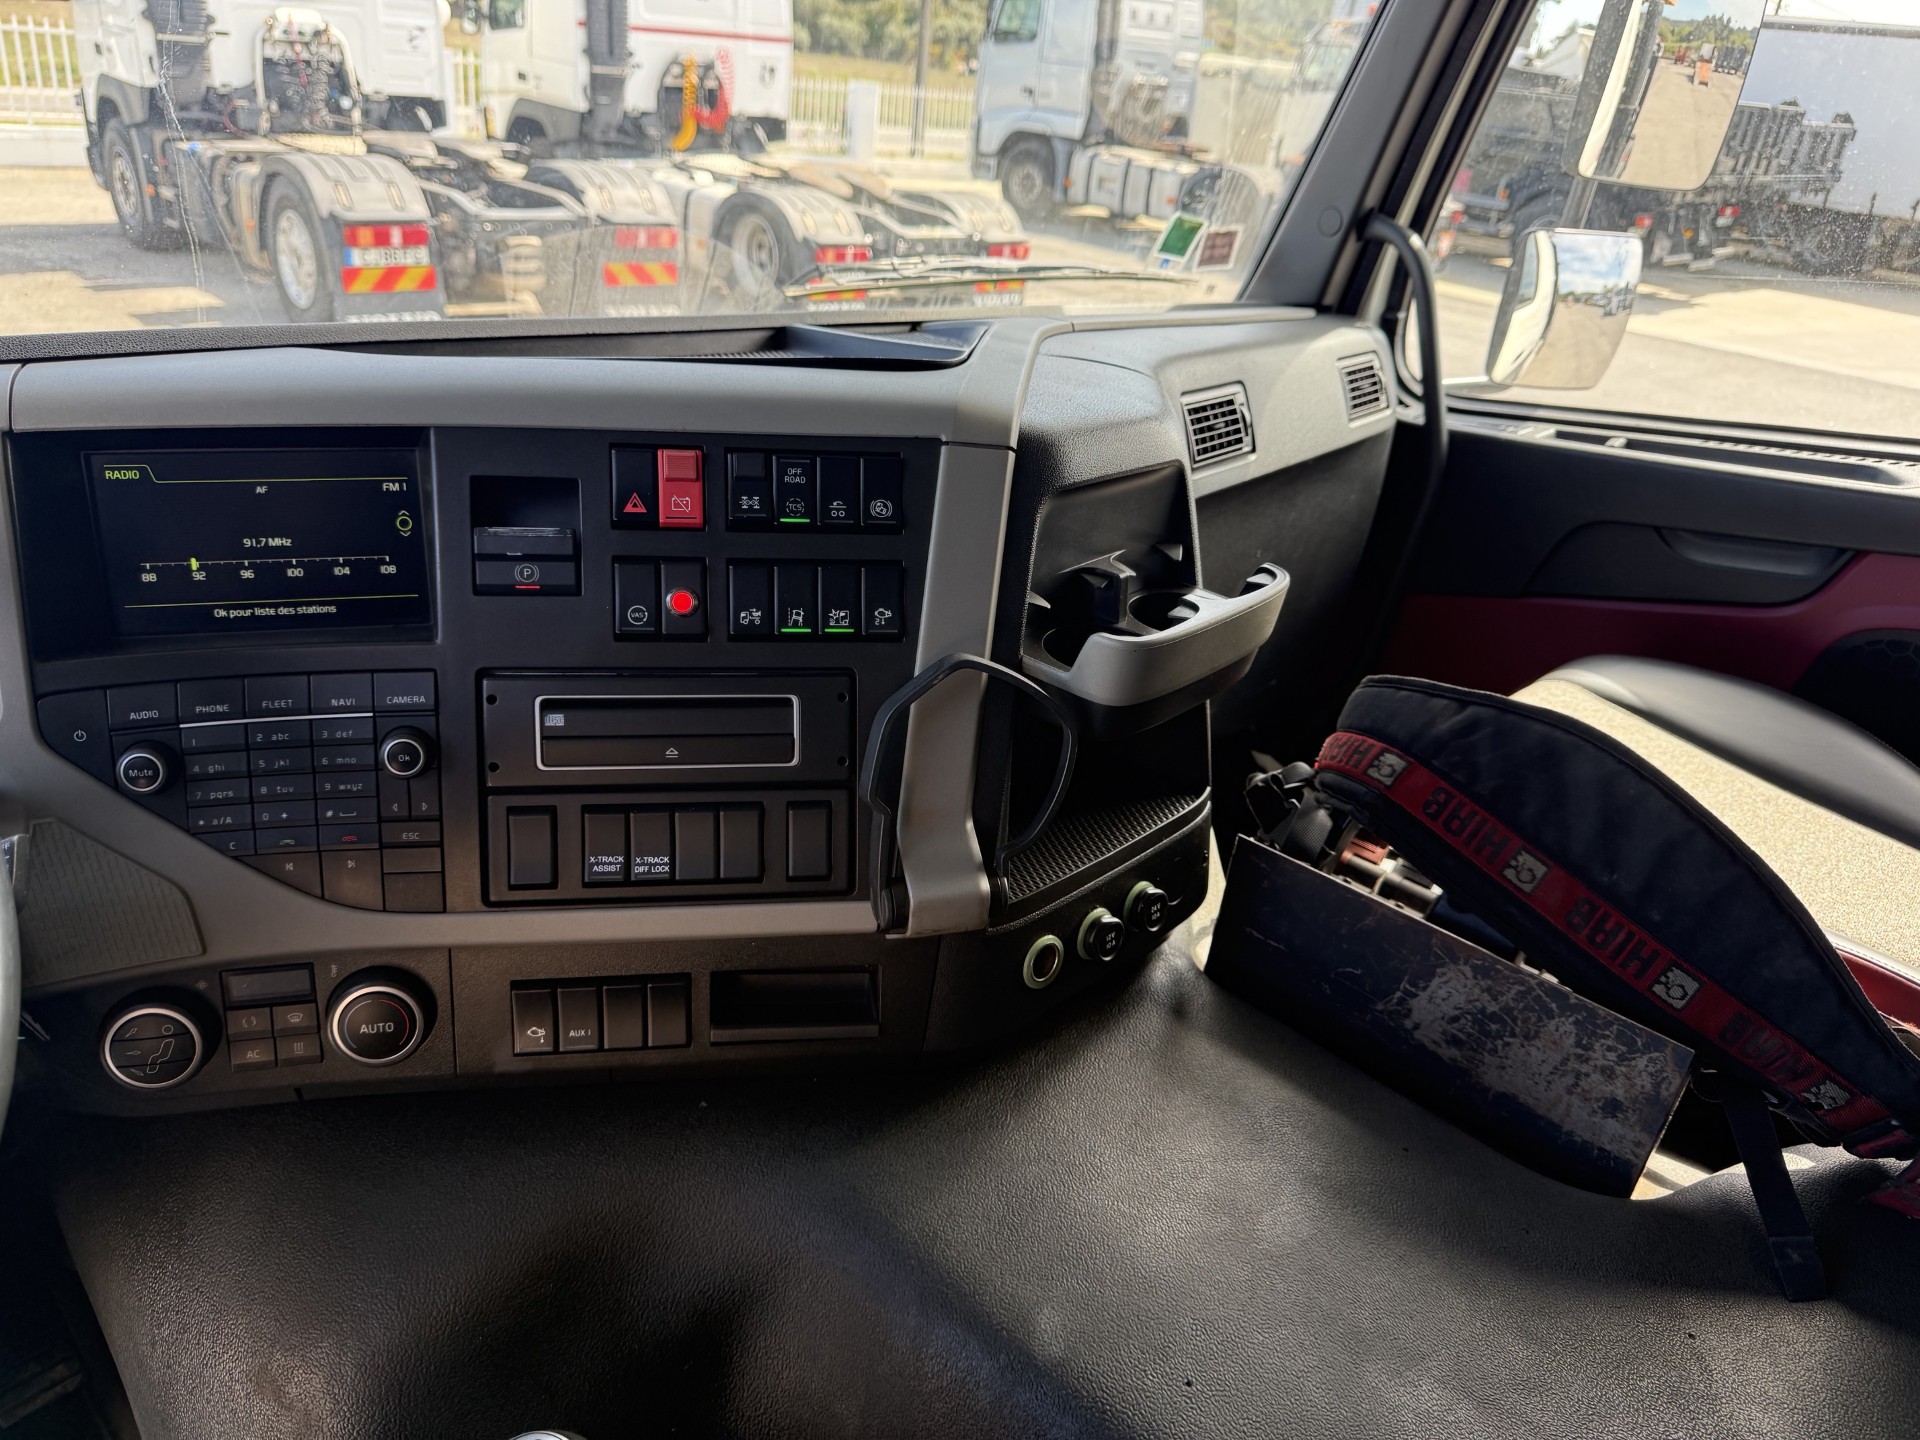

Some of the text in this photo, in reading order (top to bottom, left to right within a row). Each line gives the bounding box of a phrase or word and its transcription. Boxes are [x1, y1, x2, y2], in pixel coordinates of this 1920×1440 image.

[105, 470, 140, 480] RADIO
[787, 467, 803, 476] OFF
[784, 475, 806, 484] ROAD
[255, 486, 268, 494] AF
[383, 483, 400, 491] FM
[788, 503, 802, 511] TCS
[243, 537, 292, 547] 91.7 MHz
[287, 568, 304, 577] 100
[334, 566, 350, 575] 104
[380, 565, 397, 574] 108
[142, 573, 157, 582] 88
[192, 571, 206, 581] 92
[240, 570, 254, 579] 96
[214, 605, 337, 619] Ok pour liste des stations
[630, 611, 644, 619] VAS
[331, 697, 356, 707] NAVI
[386, 694, 426, 704] CAMERA
[196, 703, 230, 714] PHONE
[262, 699, 293, 709] FLEET
[129, 710, 159, 720] AUDIO
[256, 732, 290, 742] 2 abc
[336, 729, 353, 738] def
[322, 757, 329, 765] 6
[398, 754, 411, 762] Ok
[259, 758, 290, 769] 5 jkl
[128, 768, 154, 778] Mute
[193, 763, 225, 774] 4 ghi
[261, 785, 295, 794] 8 tuv
[324, 783, 363, 792] 9 wxyz
[209, 790, 234, 800] pqrs
[211, 816, 233, 826] a/A
[402, 832, 420, 840] ESC
[229, 841, 236, 850] C
[589, 855, 625, 864] X-TRACK
[635, 856, 670, 865] X-TRACK
[592, 864, 621, 873] ASSIST
[634, 864, 670, 874] DIFF LOCK
[359, 1022, 394, 1034] AUTO
[569, 1028, 586, 1037] AUX
[246, 1049, 260, 1059] AC
